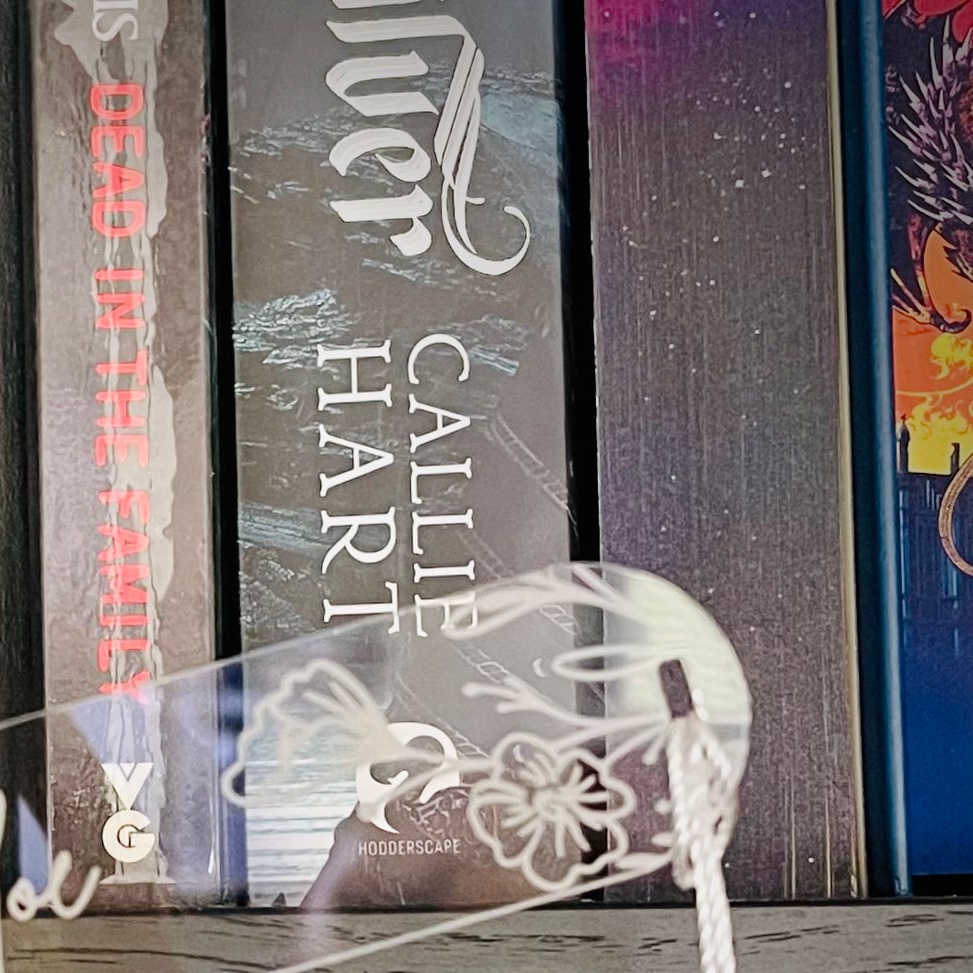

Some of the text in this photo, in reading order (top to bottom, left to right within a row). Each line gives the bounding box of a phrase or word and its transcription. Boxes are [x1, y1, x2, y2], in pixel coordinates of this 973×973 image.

[89, 82, 151, 705] DEAD IN THE FAMILY
[316, 339, 400, 634] HART
[407, 333, 478, 637] CALLIE
[358, 838, 461, 856] HODDERSCAPE
